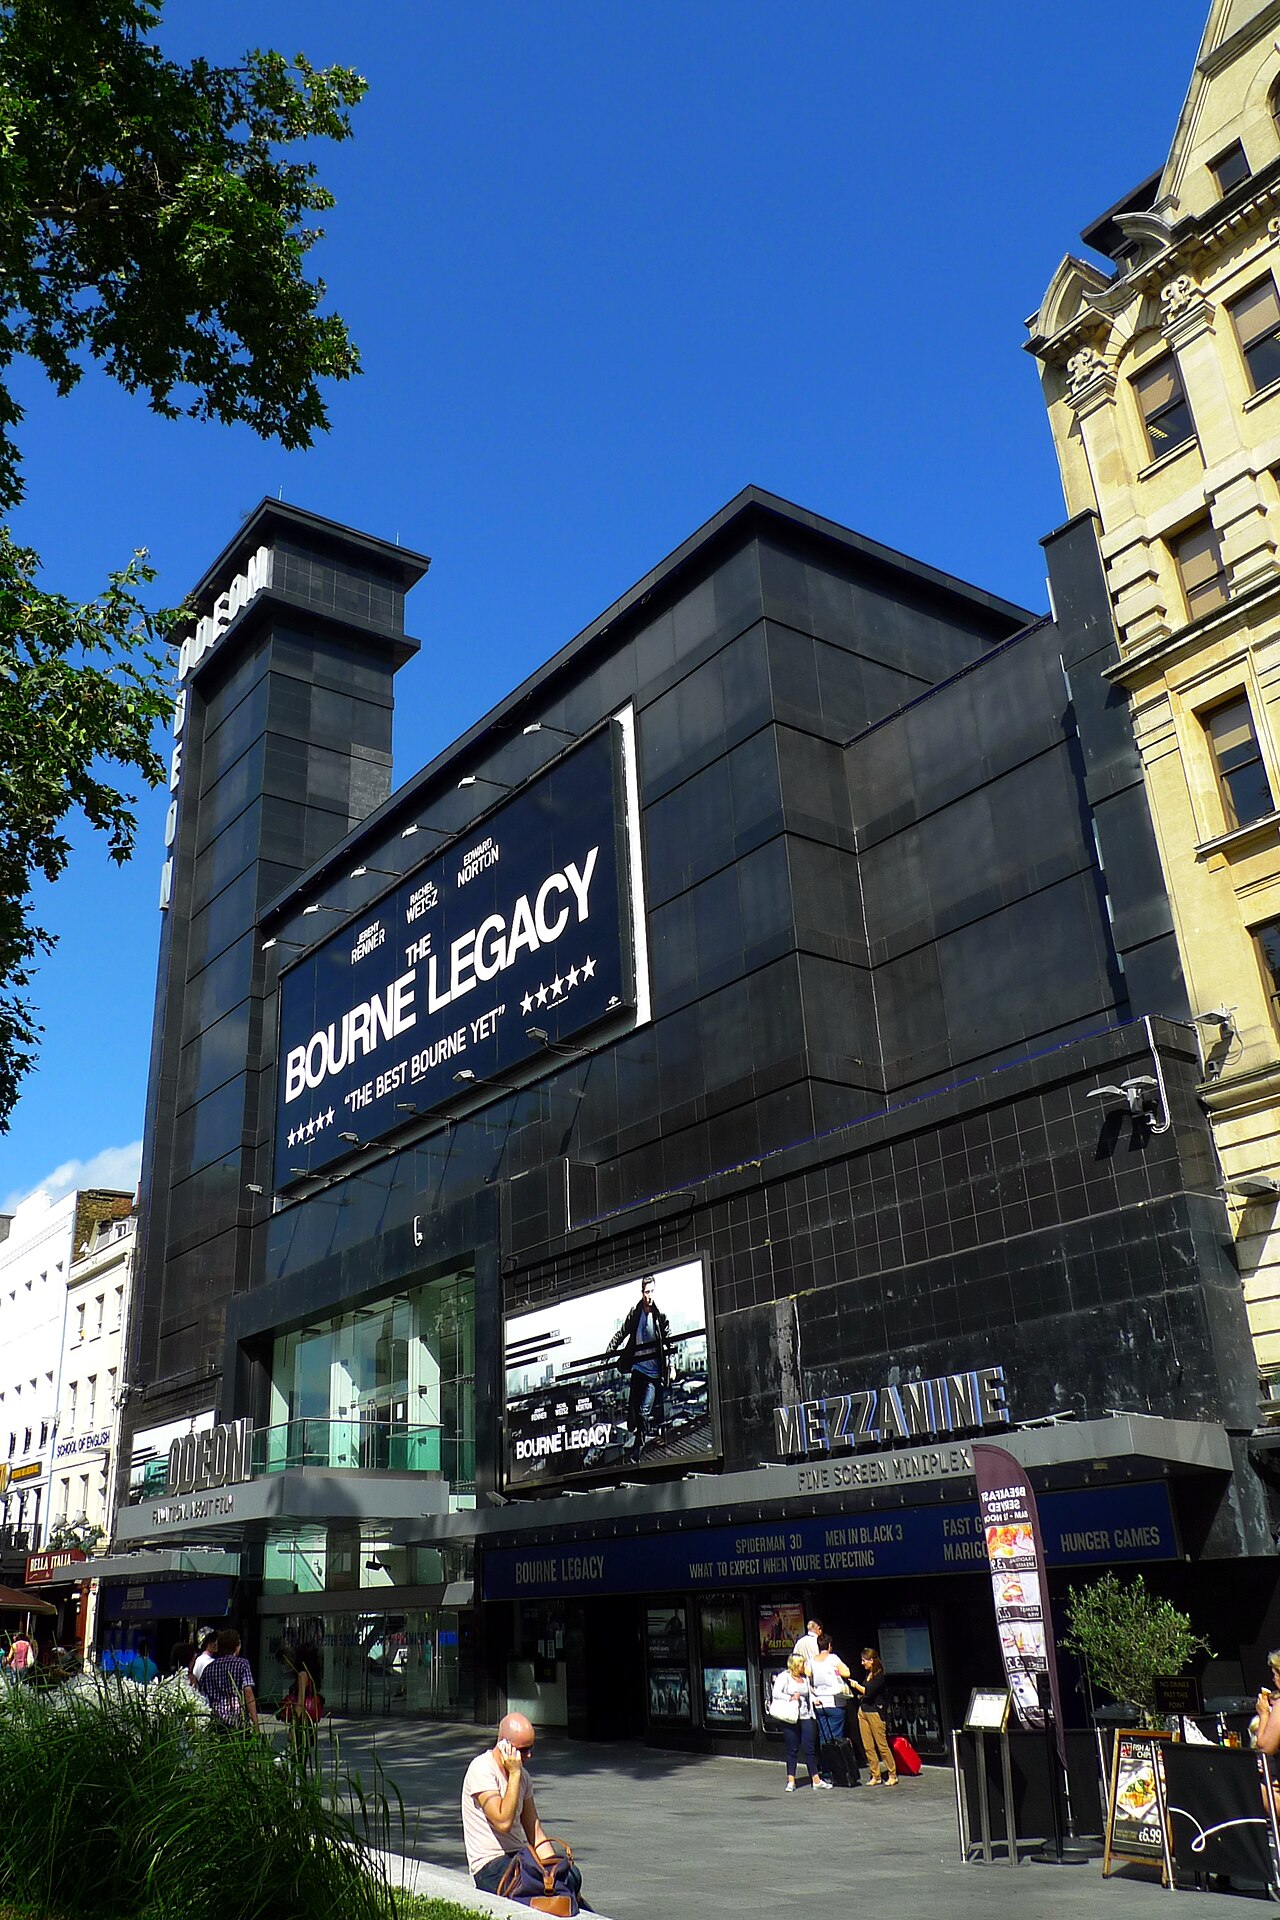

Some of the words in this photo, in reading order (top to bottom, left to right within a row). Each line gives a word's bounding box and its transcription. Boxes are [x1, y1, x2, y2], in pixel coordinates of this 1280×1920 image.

[178, 545, 274, 681] ODEON
[457, 845, 499, 888] NORTON
[463, 837, 493, 867] EDWARD
[406, 888, 439, 924] WEISZ
[409, 881, 435, 906] RACHEL
[351, 928, 386, 965] RENNER
[357, 920, 380, 945] JEREMY
[405, 933, 432, 967] THE
[284, 968, 417, 1104] BOURNE
[428, 845, 599, 1015] LEGACY
[375, 1061, 408, 1099] BEST
[411, 1027, 467, 1079] BOURNE
[772, 1366, 1010, 1455] MEZZANINE
[516, 1433, 562, 1460] BOURNE
[564, 1423, 612, 1450] LEGACY
[556, 1425, 566, 1433] THE
[57, 1440, 77, 1458] SCHOOL
[78, 1438, 86, 1451] OF
[86, 1430, 110, 1450] ENGLISH
[167, 1417, 253, 1496] ODEON
[797, 1467, 830, 1492] FIVE
[833, 1459, 888, 1486] SCREEN
[891, 1447, 973, 1480] MINIPLEX
[825, 1528, 846, 1547] MEN
[848, 1527, 859, 1545] IN
[860, 1525, 894, 1544] BLACK
[895, 1524, 903, 1541] 3
[943, 1517, 971, 1537] FAST
[1060, 1530, 1111, 1553] HUNGER
[1114, 1526, 1161, 1549] GAMES
[735, 1534, 786, 1554] SPIDERMAN
[789, 1533, 803, 1550] 3D
[30, 1556, 48, 1572] BELLA
[50, 1553, 71, 1569] ITALIA
[515, 1559, 557, 1584] BOURNE
[561, 1555, 604, 1581] LEGACY
[689, 1562, 713, 1579] WHAT
[717, 1561, 726, 1577] TO
[729, 1559, 760, 1576] EXPECT
[763, 1556, 788, 1574] WHEN
[789, 1554, 821, 1572] YOU'RE
[823, 1550, 875, 1570] EXPECTING
[1132, 1743, 1144, 1752] FISH
[1138, 1826, 1162, 1844] £6.99
